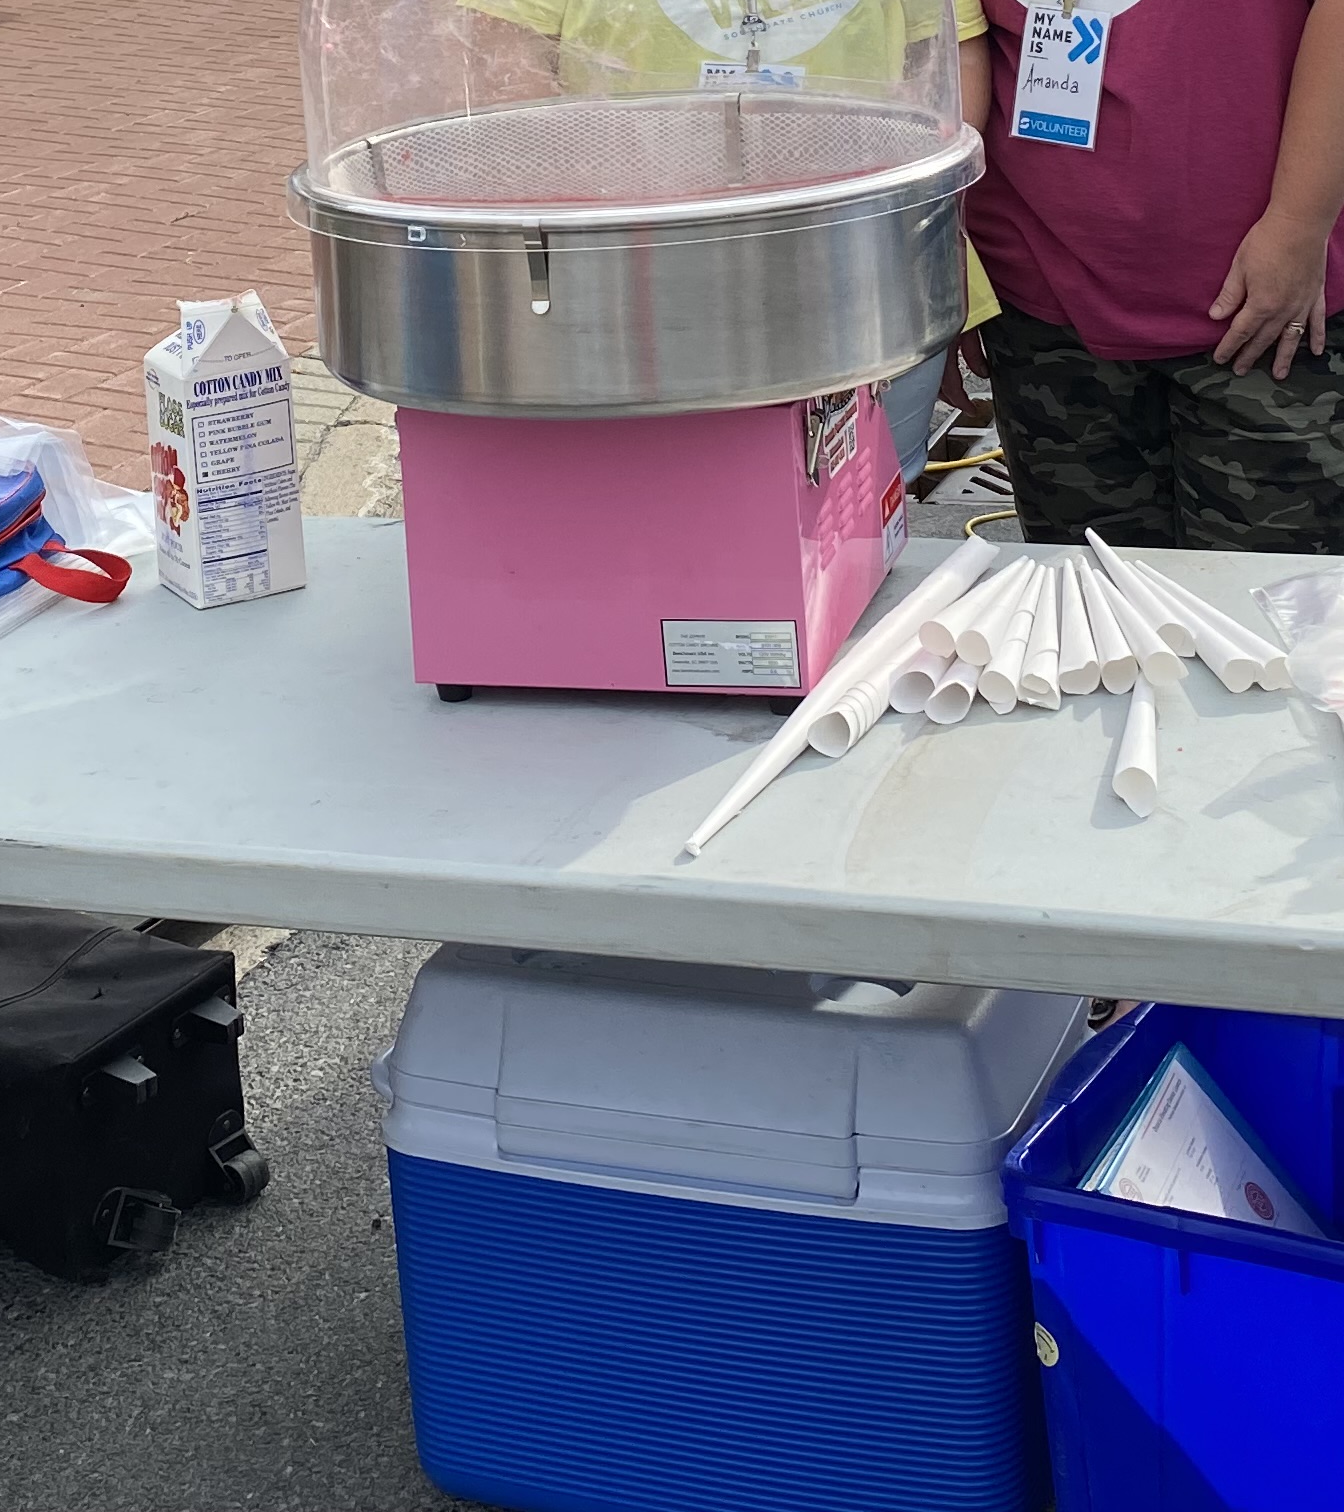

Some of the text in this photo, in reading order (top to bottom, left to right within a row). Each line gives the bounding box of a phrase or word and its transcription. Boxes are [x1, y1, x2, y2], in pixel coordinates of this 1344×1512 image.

[1034, 12, 1056, 26] MY
[1032, 26, 1073, 44] NAME
[1030, 40, 1043, 53] IS
[1022, 62, 1079, 94] Amanda
[1030, 119, 1088, 138] VOLUNTEER
[194, 365, 284, 398] COTTON CANDY MIX
[274, 381, 291, 394] Candy
[207, 412, 255, 427] STRAWBERRY
[208, 418, 273, 437] PINK BUBBLE GUM
[209, 432, 258, 447] WATERMELON
[210, 446, 239, 457] YELLOW
[257, 436, 285, 448] COLADA
[210, 457, 236, 467] GRAPE
[211, 465, 241, 476] CHERRY
[196, 477, 262, 494] Nutrition Facts
